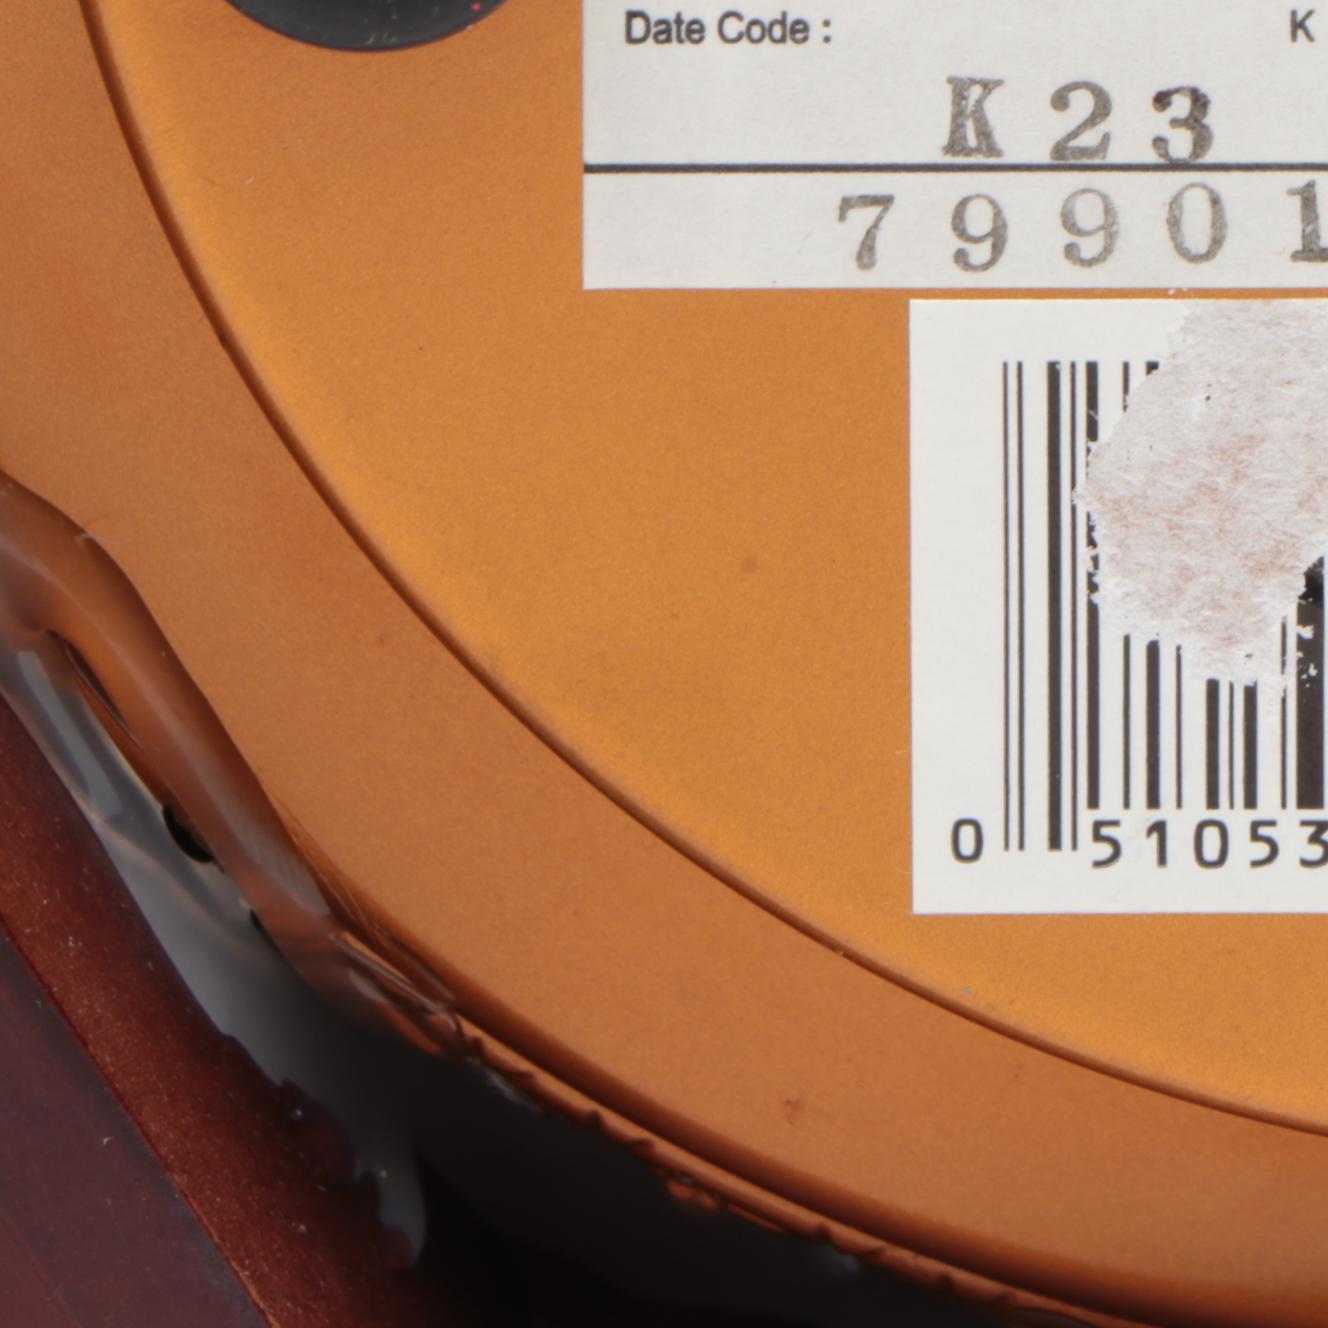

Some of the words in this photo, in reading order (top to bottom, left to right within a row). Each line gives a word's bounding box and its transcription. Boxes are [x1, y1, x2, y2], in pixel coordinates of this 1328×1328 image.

[625, 10, 705, 44] Date
[718, 11, 809, 44] Code
[1291, 10, 1313, 42] K
[951, 818, 984, 863] 0
